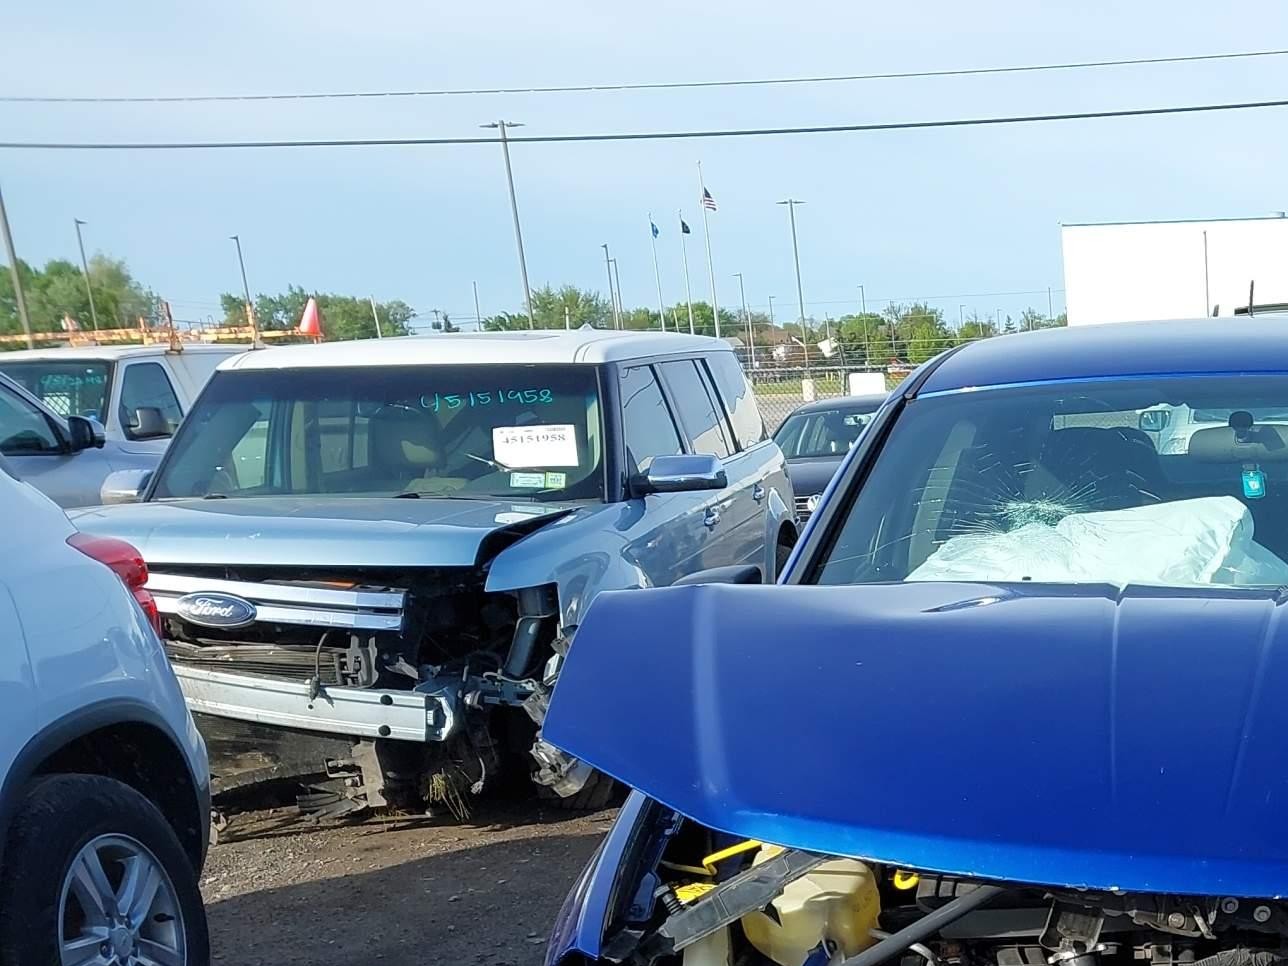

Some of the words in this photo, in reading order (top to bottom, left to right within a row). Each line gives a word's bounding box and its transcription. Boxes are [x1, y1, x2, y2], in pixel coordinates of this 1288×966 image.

[420, 389, 553, 411] 45151958
[502, 434, 566, 445] 45151958
[190, 598, 233, 617] Ford
